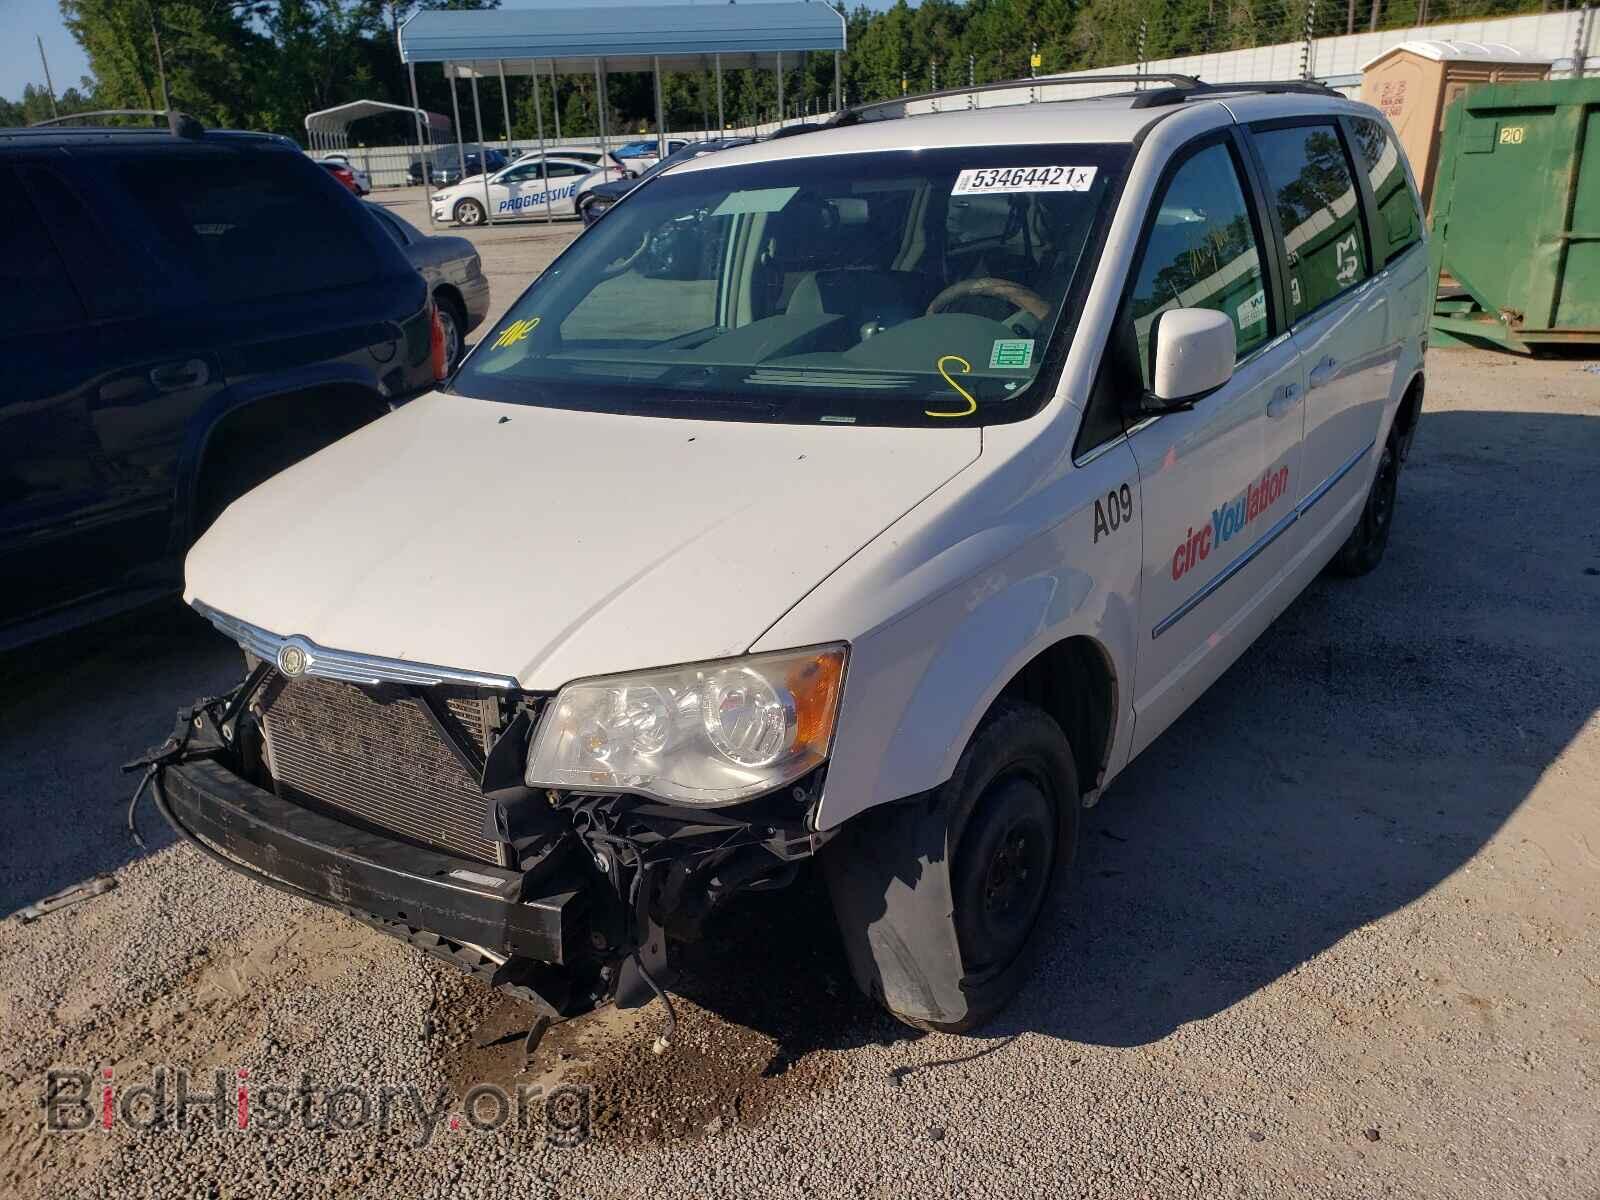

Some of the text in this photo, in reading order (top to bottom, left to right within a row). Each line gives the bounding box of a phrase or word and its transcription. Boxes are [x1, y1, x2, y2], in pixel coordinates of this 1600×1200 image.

[1502, 129, 1521, 143] 20
[1093, 482, 1133, 545] A09
[1171, 464, 1289, 581] circYoulation
